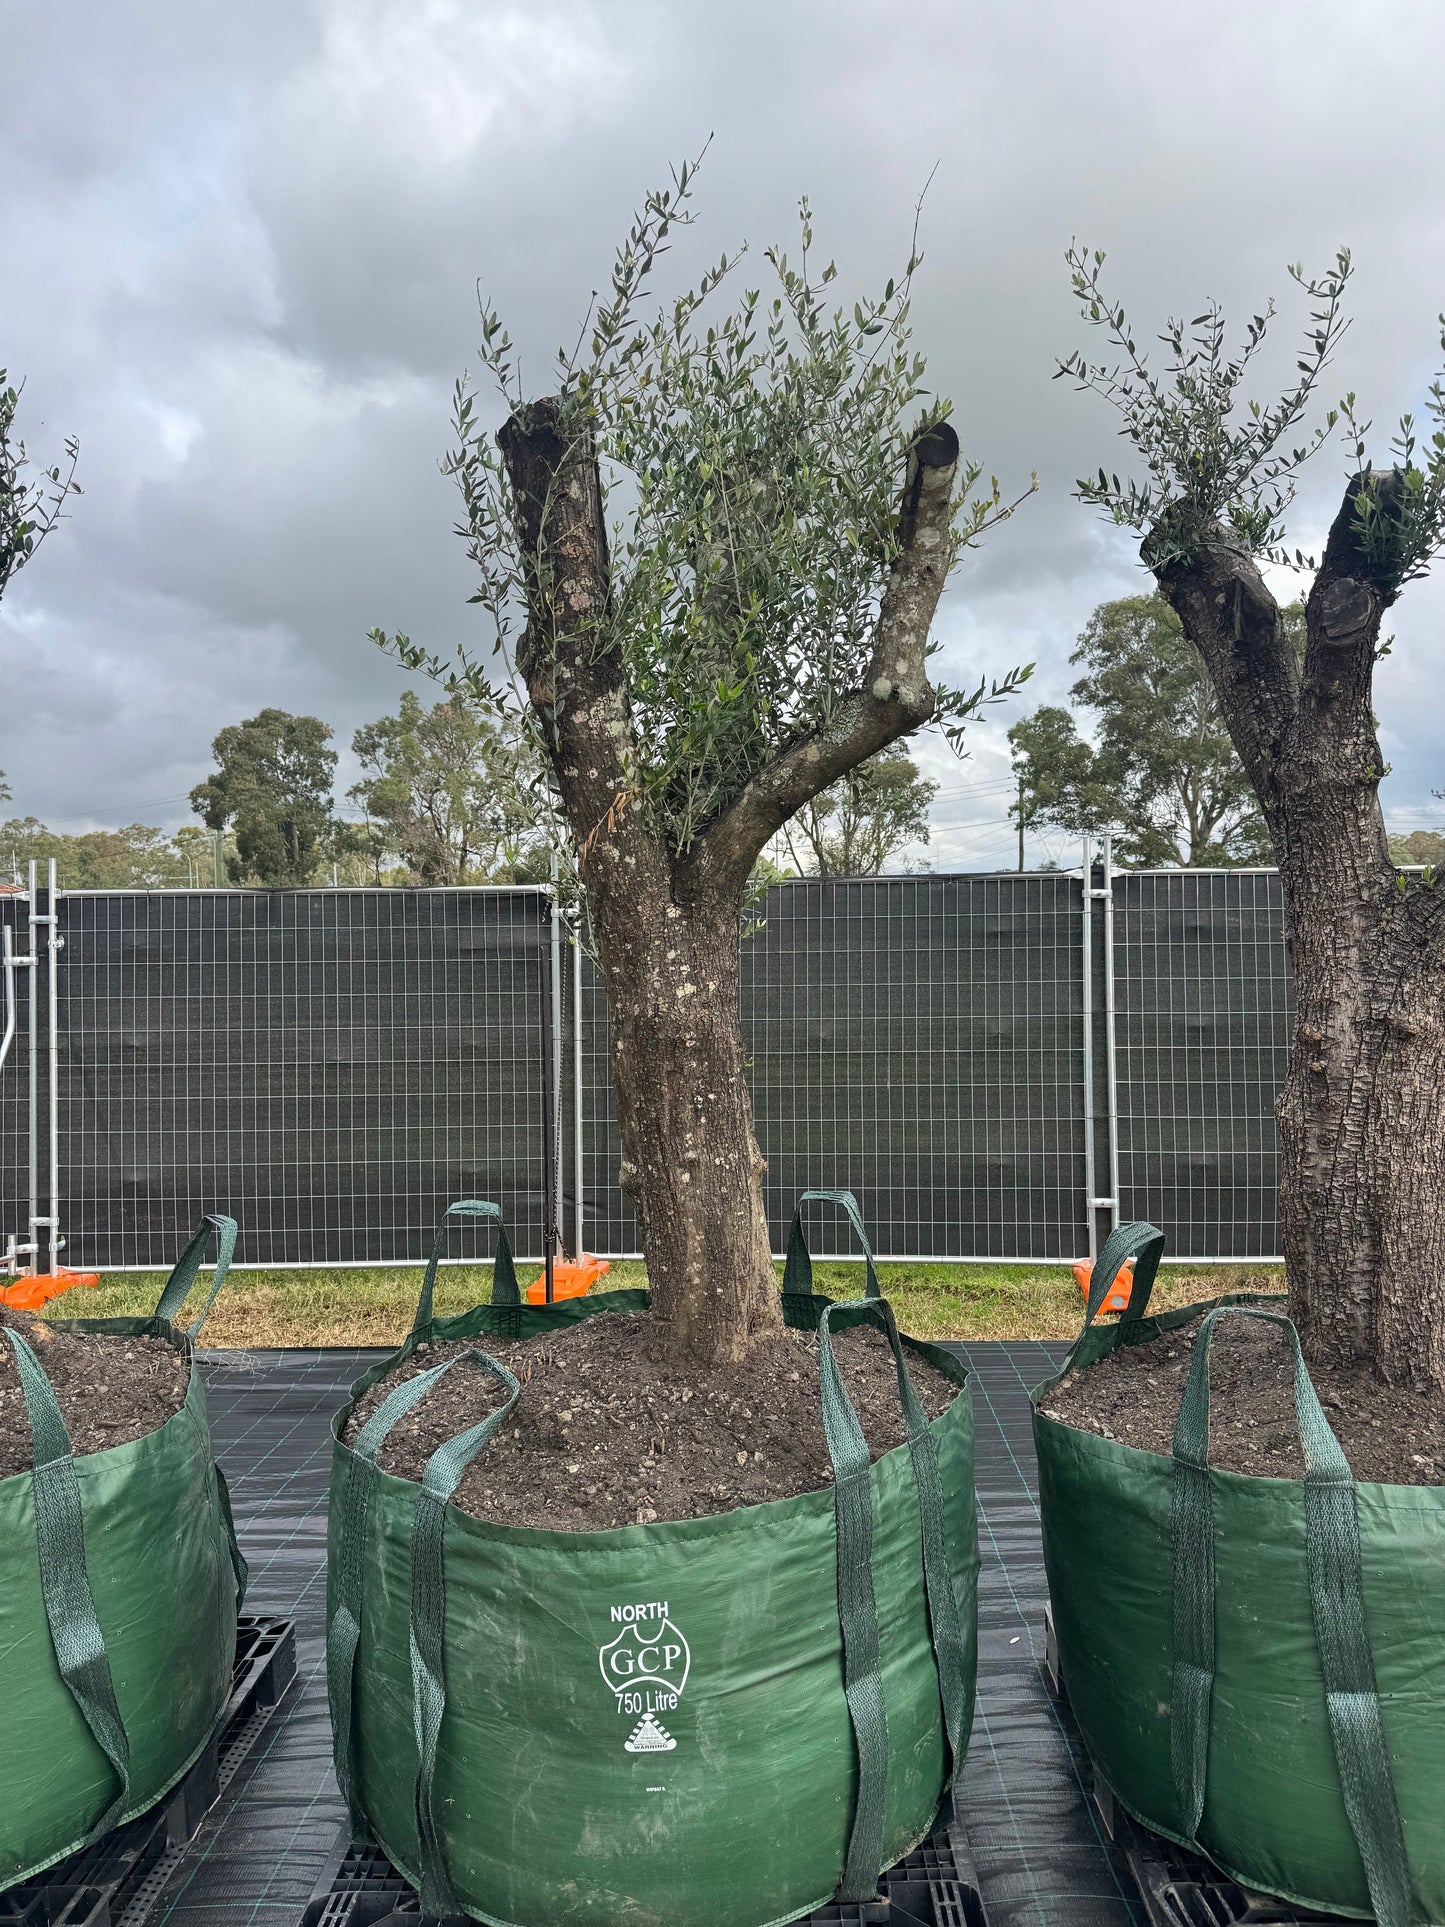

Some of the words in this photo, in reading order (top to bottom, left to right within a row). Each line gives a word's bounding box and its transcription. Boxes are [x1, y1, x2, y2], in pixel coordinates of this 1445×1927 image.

[610, 1601, 669, 1622] NORTH
[610, 1644, 681, 1675] GCP
[615, 1692, 642, 1714] 750
[646, 1690, 678, 1712] Litre
